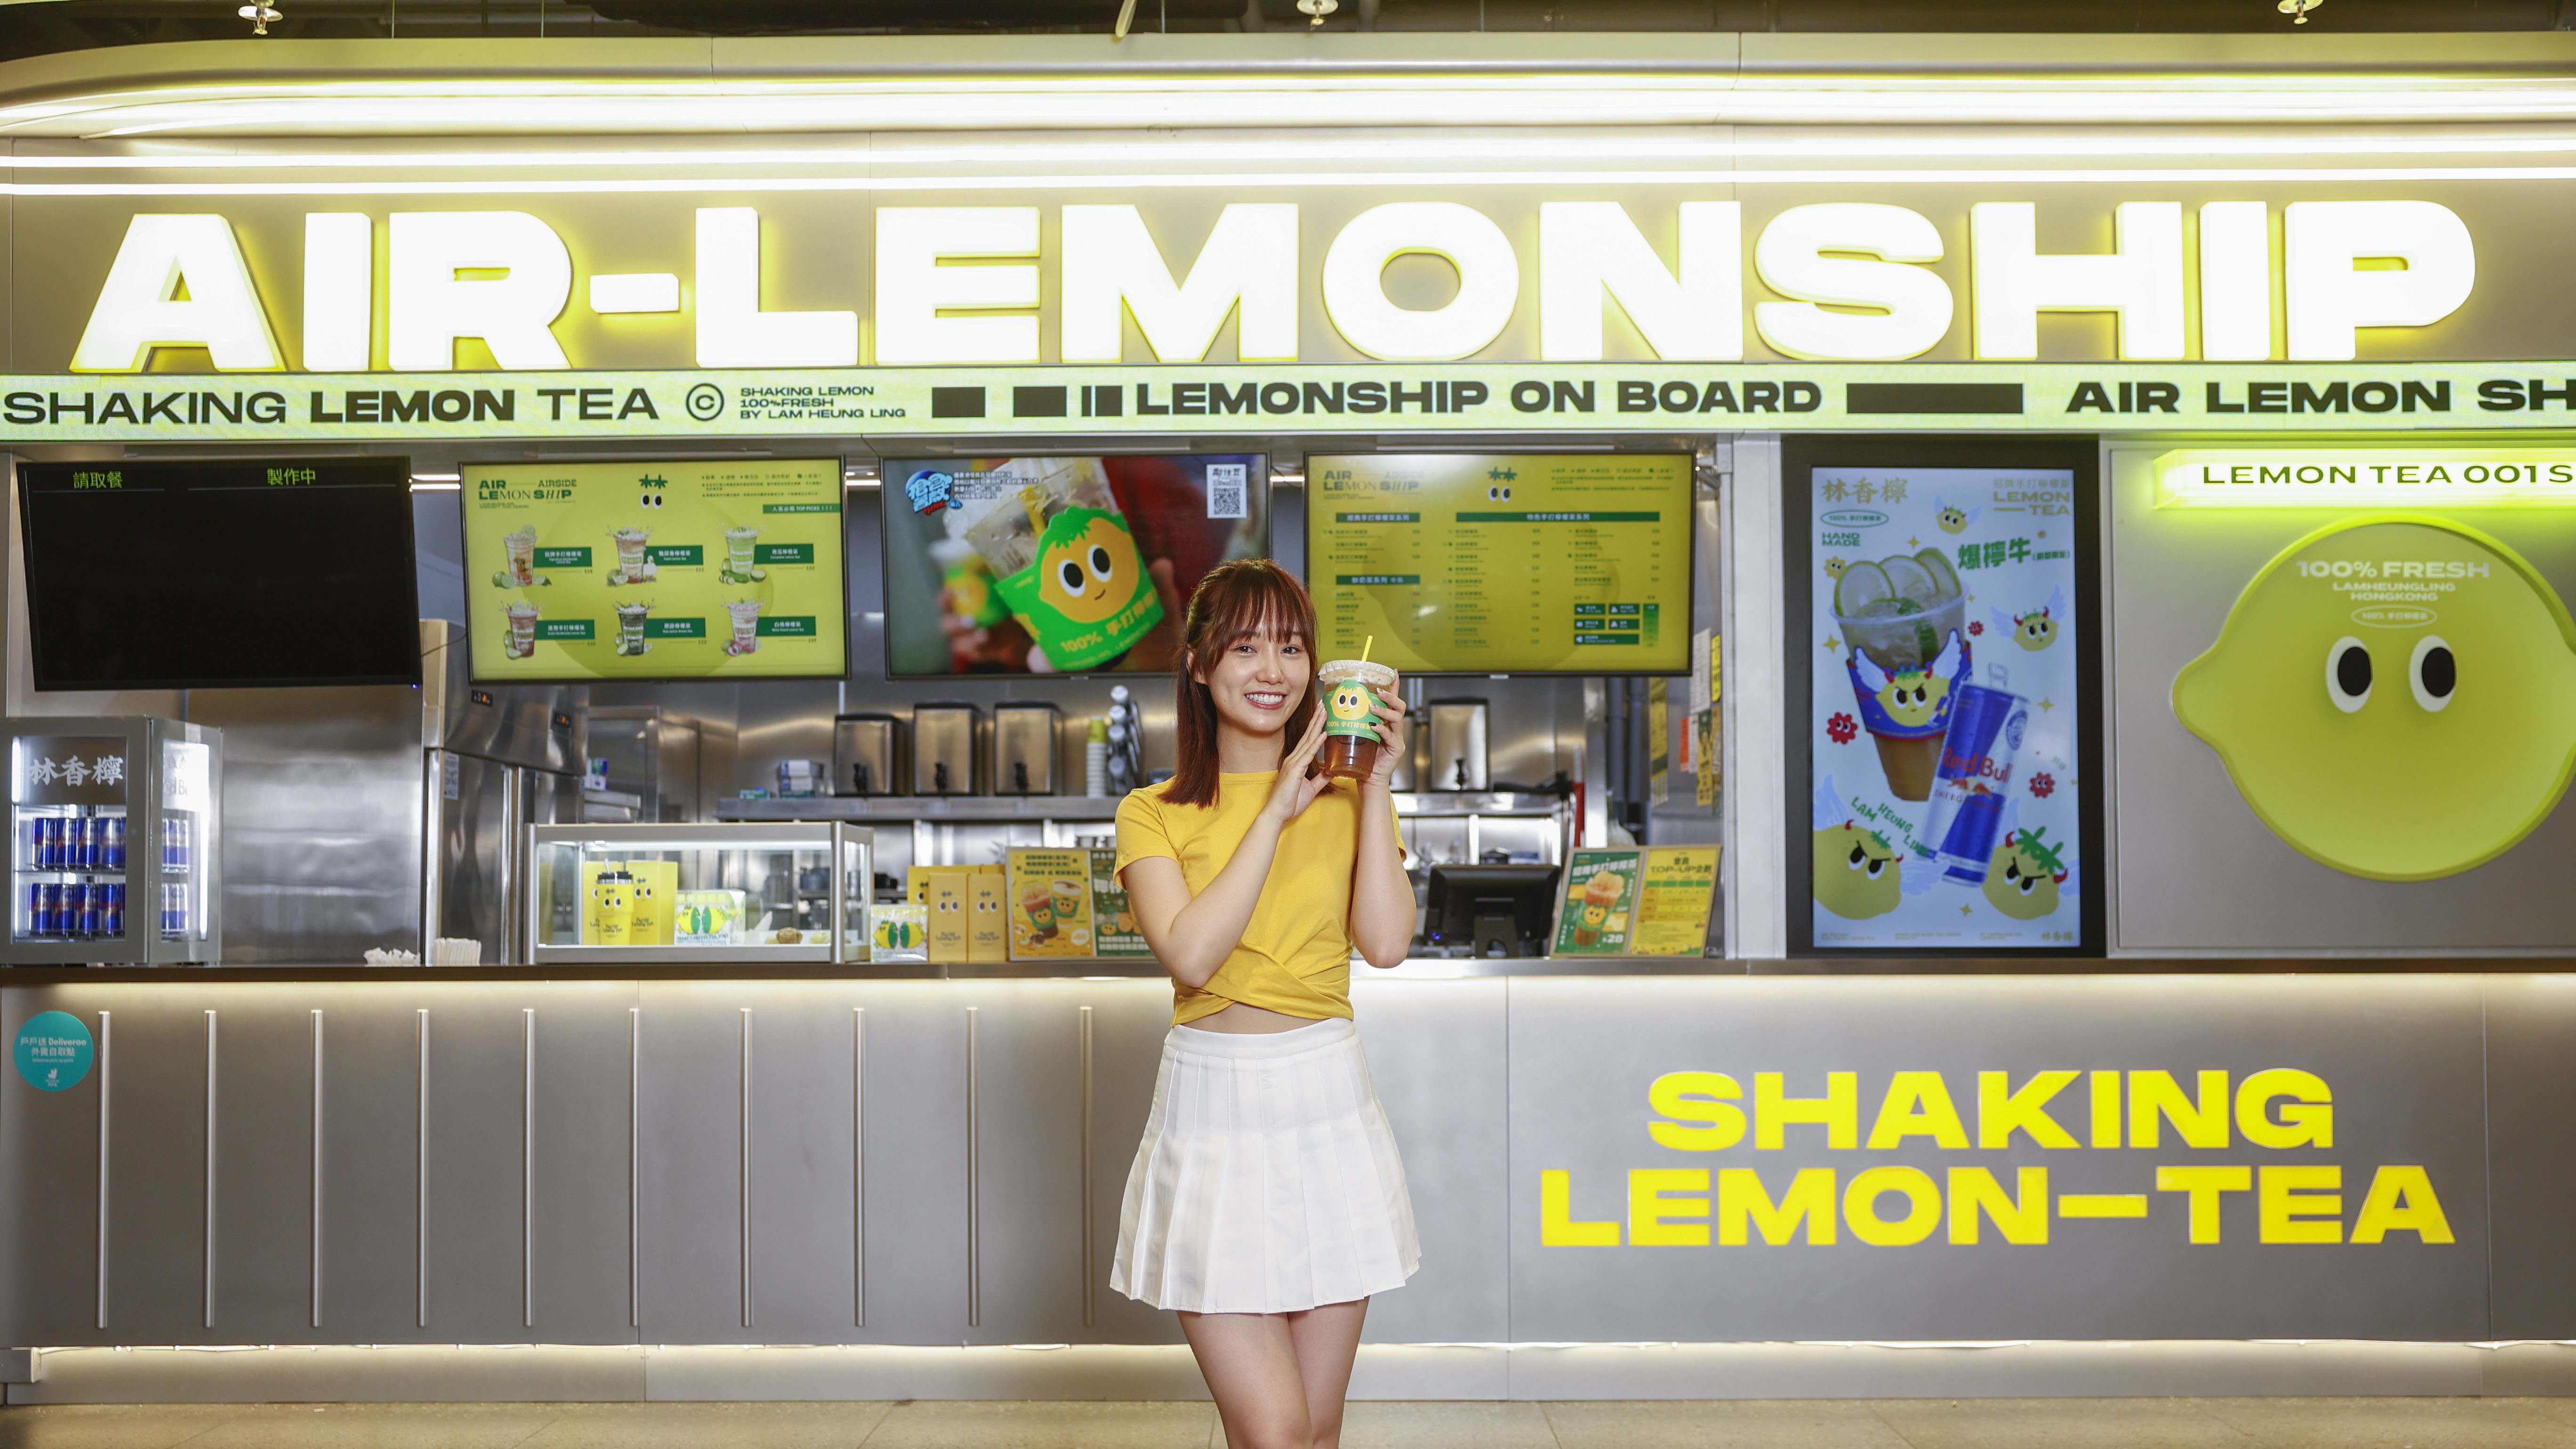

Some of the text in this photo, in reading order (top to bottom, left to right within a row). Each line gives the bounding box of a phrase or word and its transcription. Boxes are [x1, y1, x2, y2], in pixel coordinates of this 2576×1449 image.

[68, 200, 2476, 372] AIR-LEMONSHIP
[741, 386, 874, 396] SHAKING LEMON
[1137, 380, 1821, 414] LEMONSHIP ON BOARD
[2066, 379, 2576, 412] AIR LEMON SH
[4, 388, 659, 424] SHAKING LEMON TEA
[741, 408, 906, 419] BY LAM HEUNG LING
[73, 471, 122, 489] 請取餐
[266, 467, 316, 485] 製作中
[1324, 471, 1352, 480] AIR
[2204, 466, 2355, 484] LEMON
[2369, 465, 2451, 484] TEA
[2464, 465, 2536, 483] 001
[479, 479, 577, 489] AIR AIRSIDE
[1323, 482, 1377, 491] LEMON
[1821, 477, 1908, 504] 林香檸
[479, 490, 530, 499] LEMON
[1994, 491, 2070, 503] LEMON
[2029, 505, 2071, 516] TEA
[2297, 560, 2490, 578] 100% FRESH
[2333, 582, 2455, 592] LAMHEUNGLING
[2351, 592, 2438, 601] HONGKONG
[1061, 631, 1103, 652] 100%
[31, 755, 124, 786] 林香檸
[1943, 747, 2013, 783] Red Bull
[1852, 797, 1877, 821] LAM
[1878, 803, 1913, 833] HEUNG
[48, 1037, 87, 1046] Deliveroo
[1648, 1068, 2334, 1151] SHAKING
